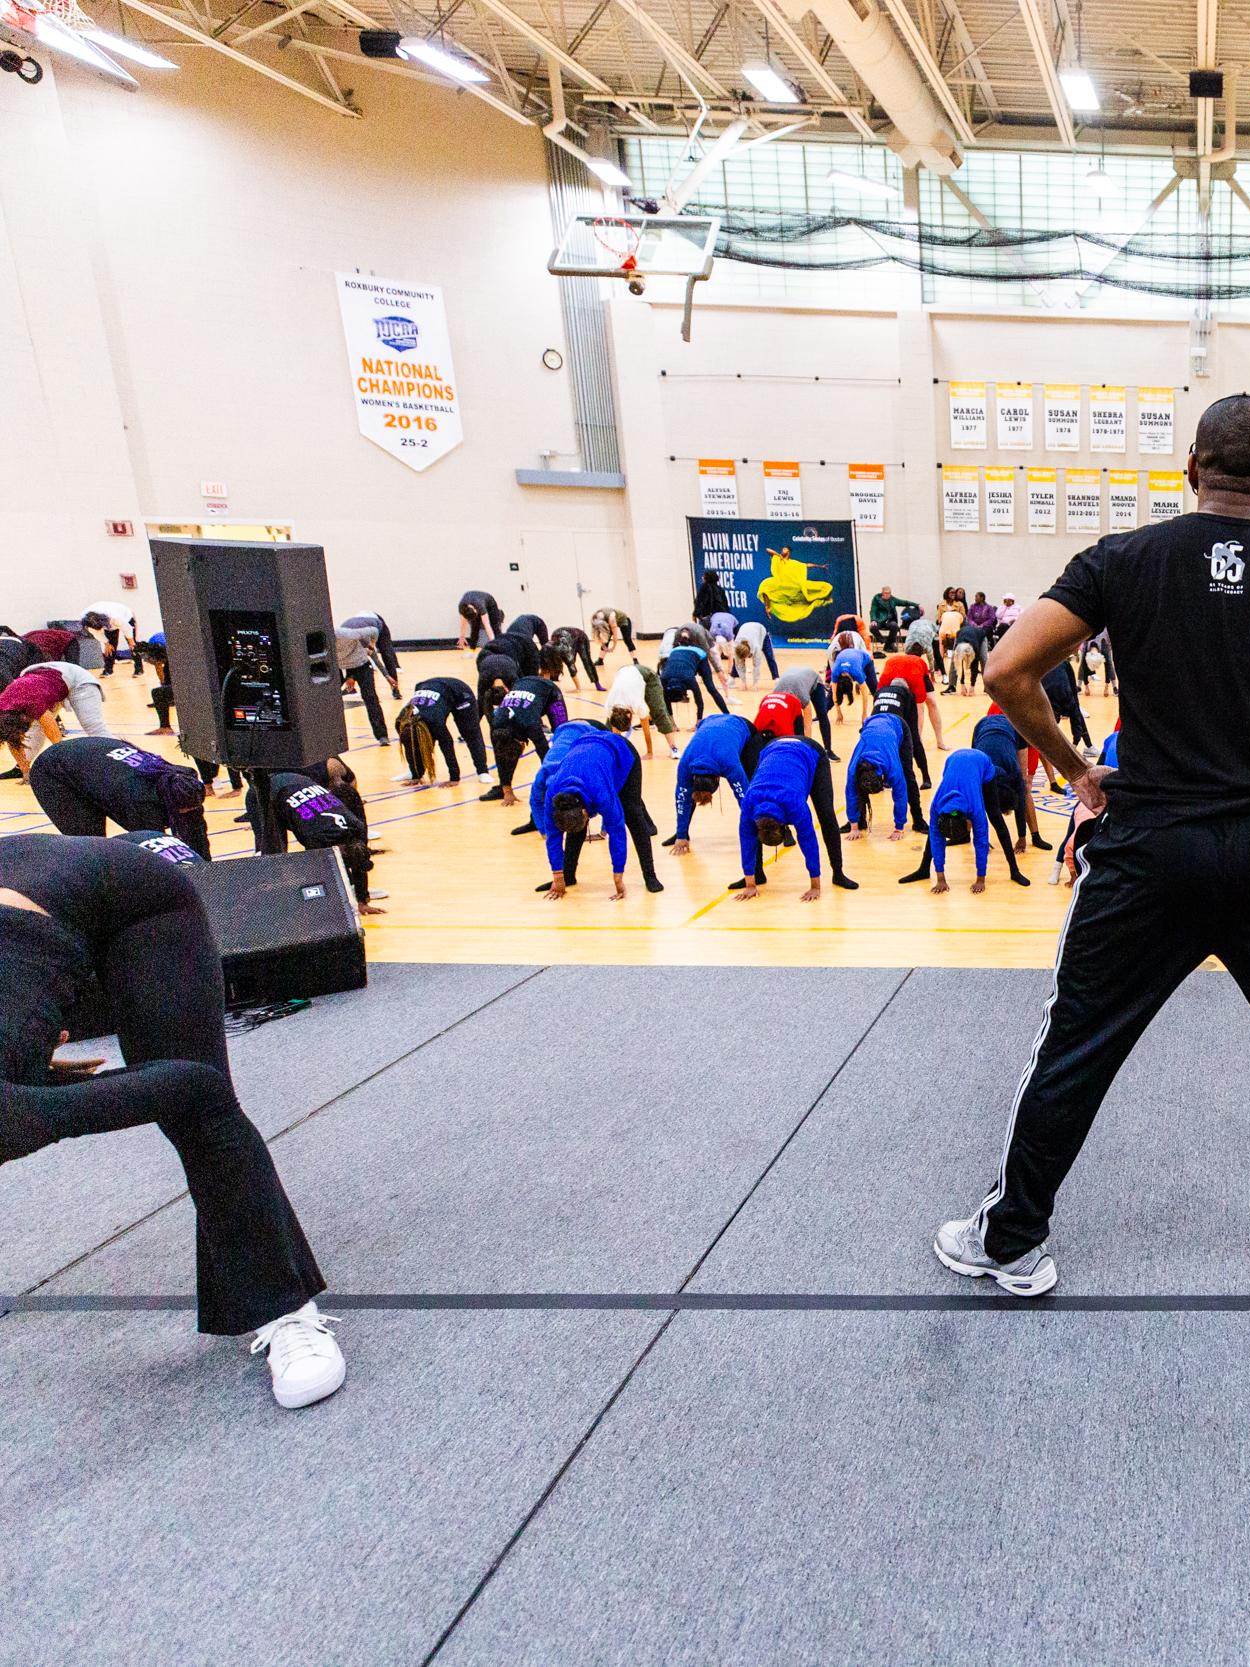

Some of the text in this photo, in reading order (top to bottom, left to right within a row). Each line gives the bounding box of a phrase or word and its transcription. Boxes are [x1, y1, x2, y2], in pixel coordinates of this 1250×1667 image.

[344, 281, 435, 301] ROXBURY COMMUNITY
[374, 297, 411, 309] COLLEGE
[361, 357, 443, 382] NATIONAL
[357, 377, 455, 402] CHAMPIONS
[361, 398, 455, 414] WOMEN'S BASKETBALL
[1000, 408, 1030, 416] CAROL
[1048, 409, 1078, 417] SUSAN
[383, 413, 438, 432] 2016
[1141, 412, 1171, 420] SUSAN
[400, 437, 428, 448] 25-2
[702, 532, 759, 552] ALVIN AILEY
[704, 551, 754, 571] AMERICAN
[716, 571, 736, 589] NCE
